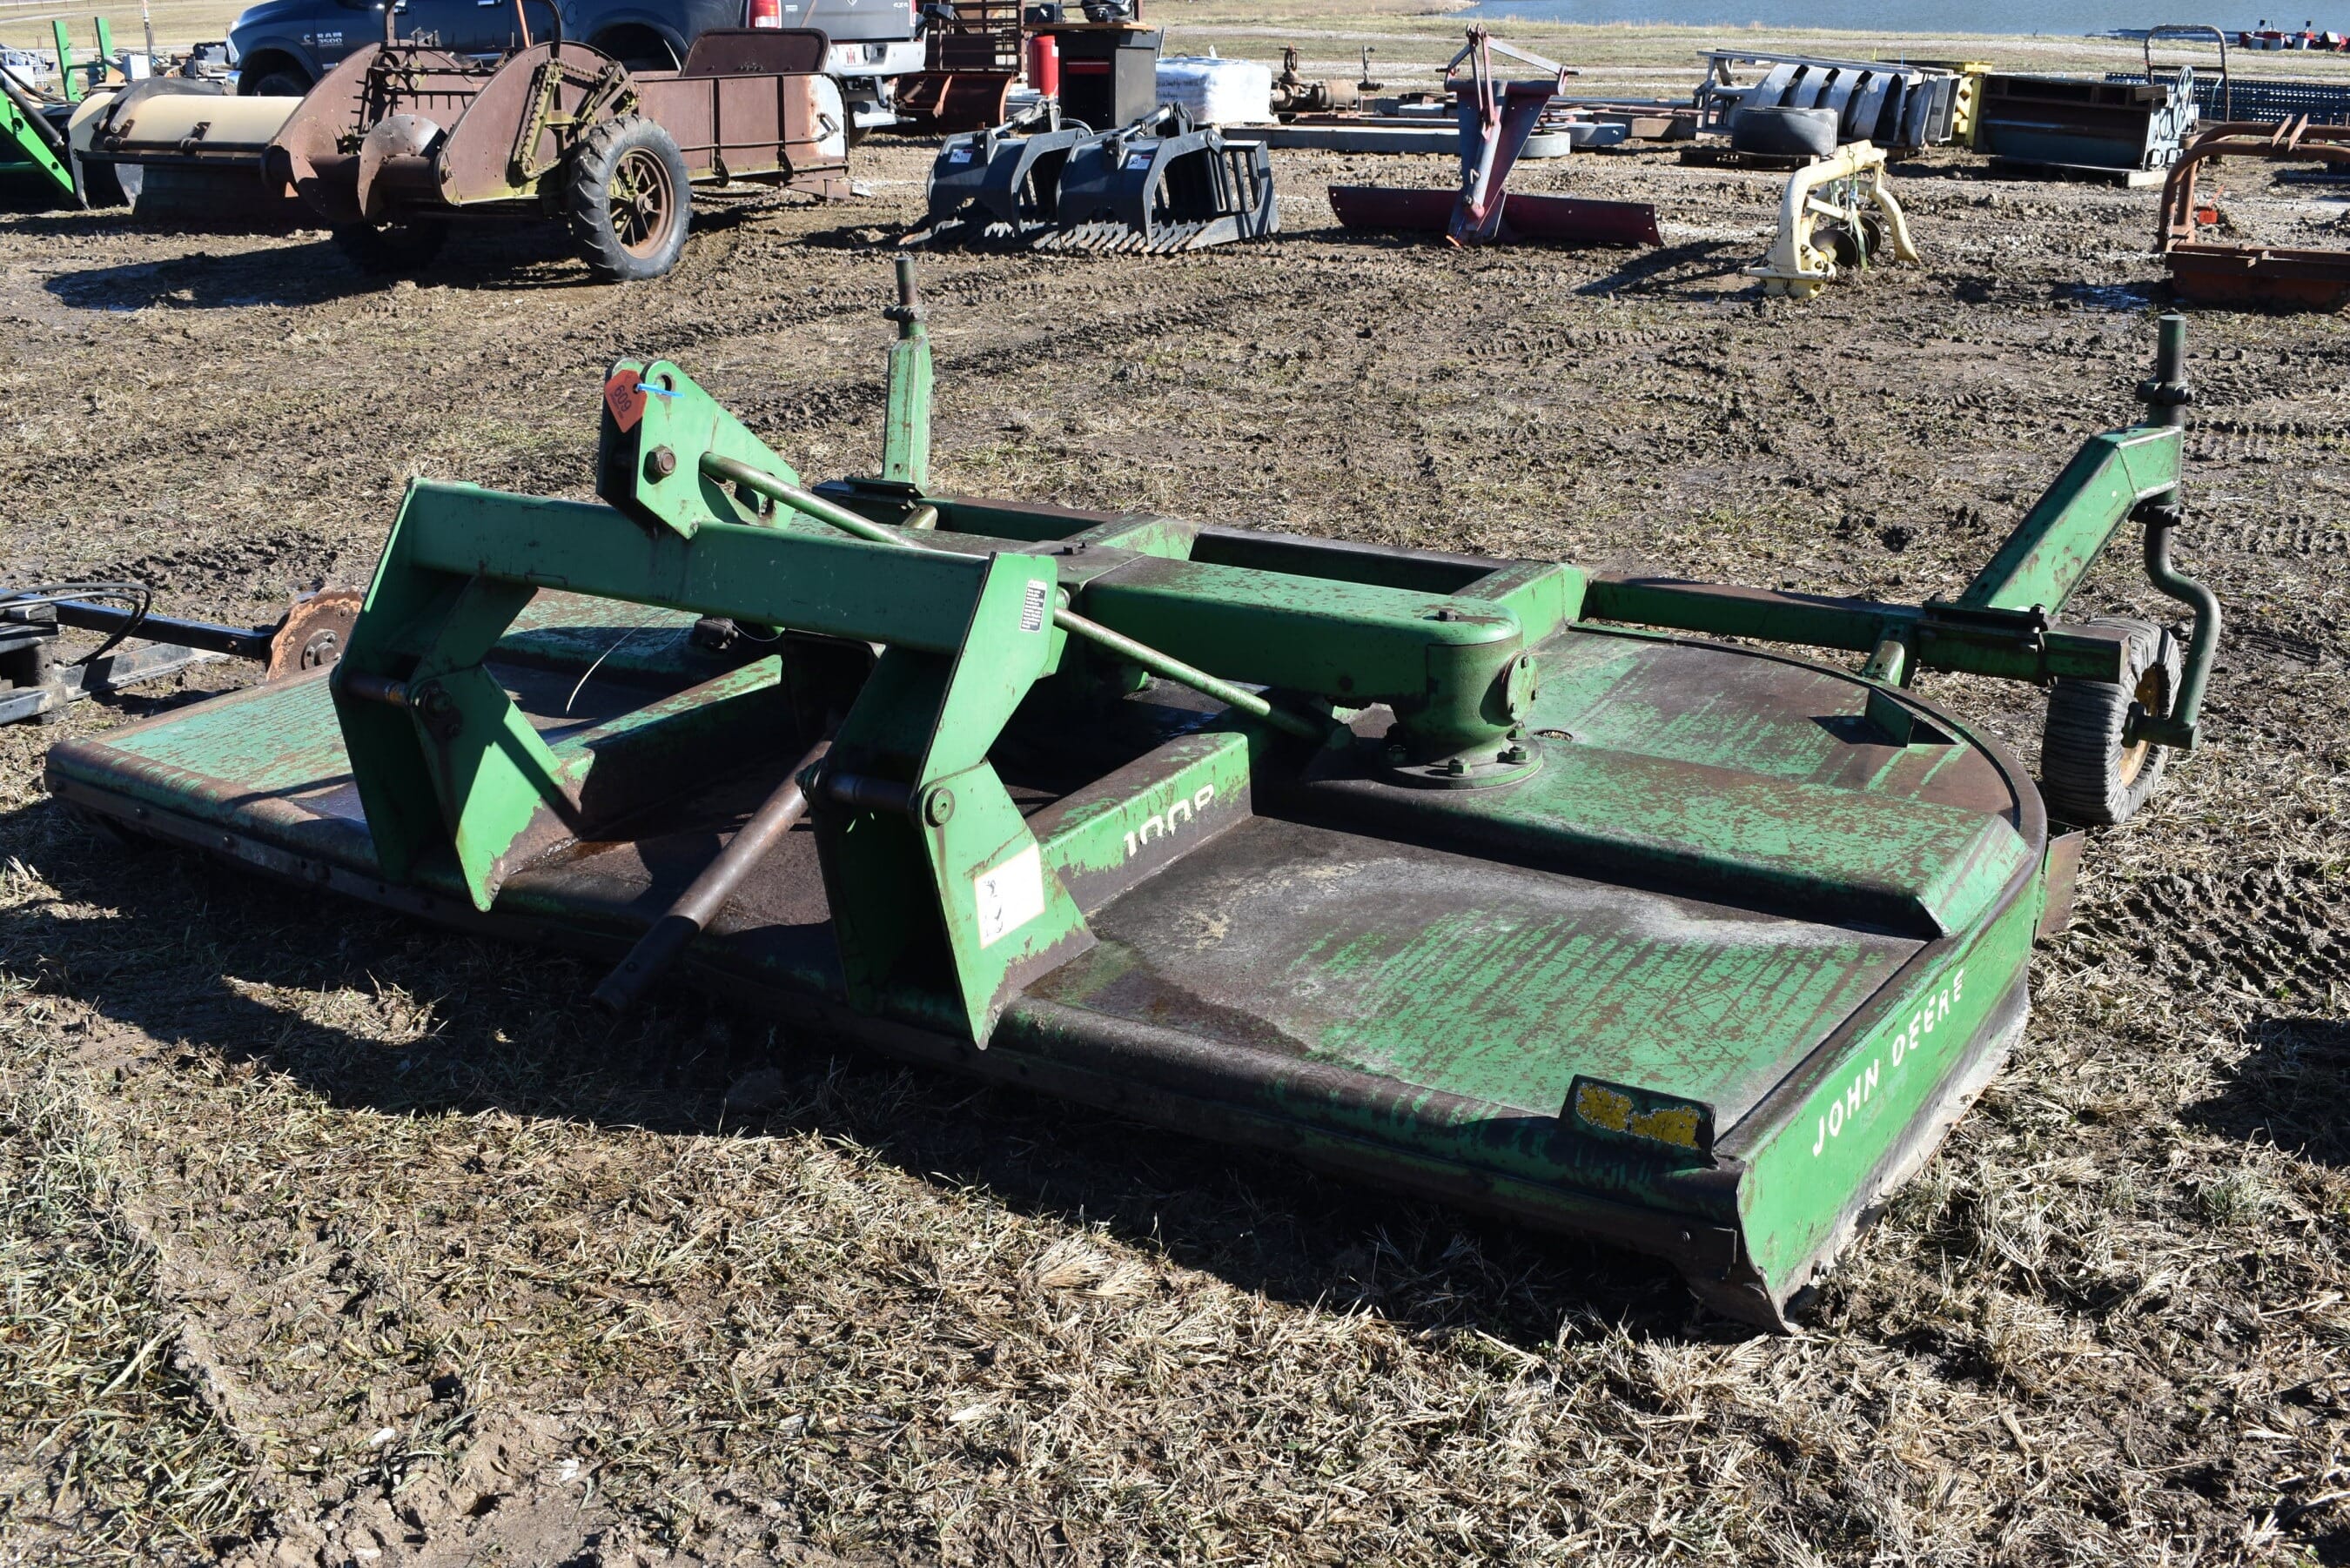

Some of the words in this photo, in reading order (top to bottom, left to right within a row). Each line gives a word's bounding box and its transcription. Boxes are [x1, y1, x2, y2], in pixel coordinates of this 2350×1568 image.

[614, 385, 632, 412] 609
[1812, 1058, 1879, 1157] JOHN
[1891, 968, 1964, 1068] DEERE
